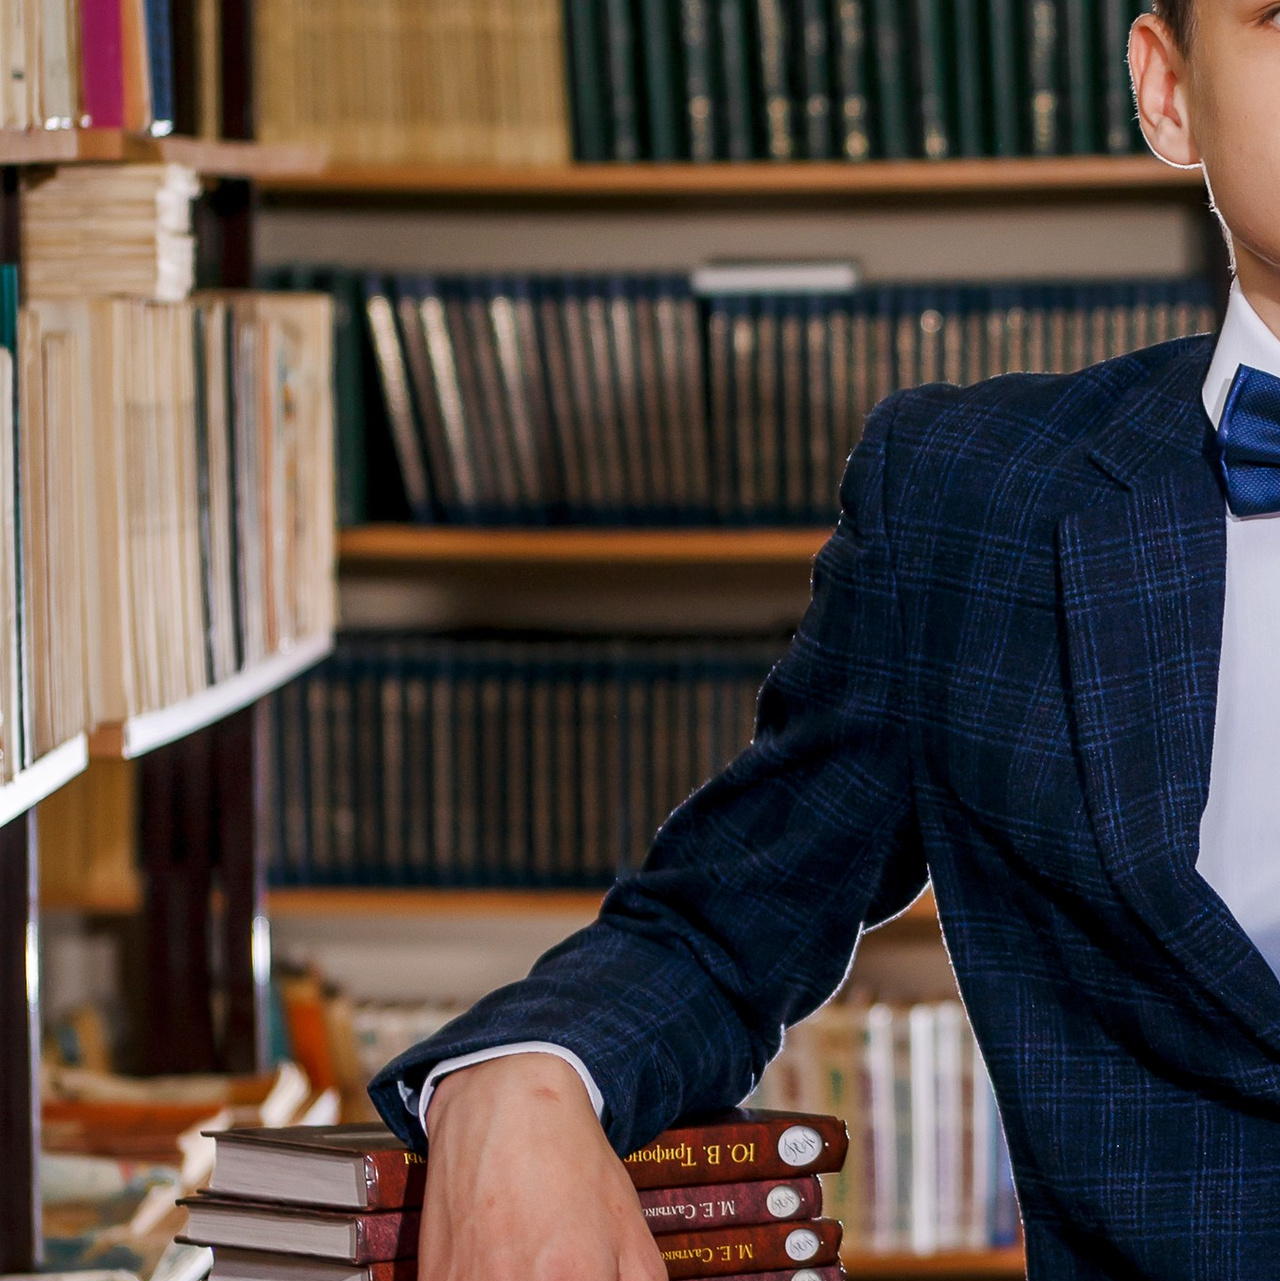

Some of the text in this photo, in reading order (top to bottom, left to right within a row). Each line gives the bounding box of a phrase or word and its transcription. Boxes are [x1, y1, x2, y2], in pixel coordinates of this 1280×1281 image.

[703, 1145, 720, 1165] В.
[727, 1143, 755, 1163] Ю.
[700, 1201, 713, 1218] Е.
[718, 1200, 736, 1216] М.
[717, 1245, 731, 1262] Е.
[735, 1243, 753, 1259] М.
